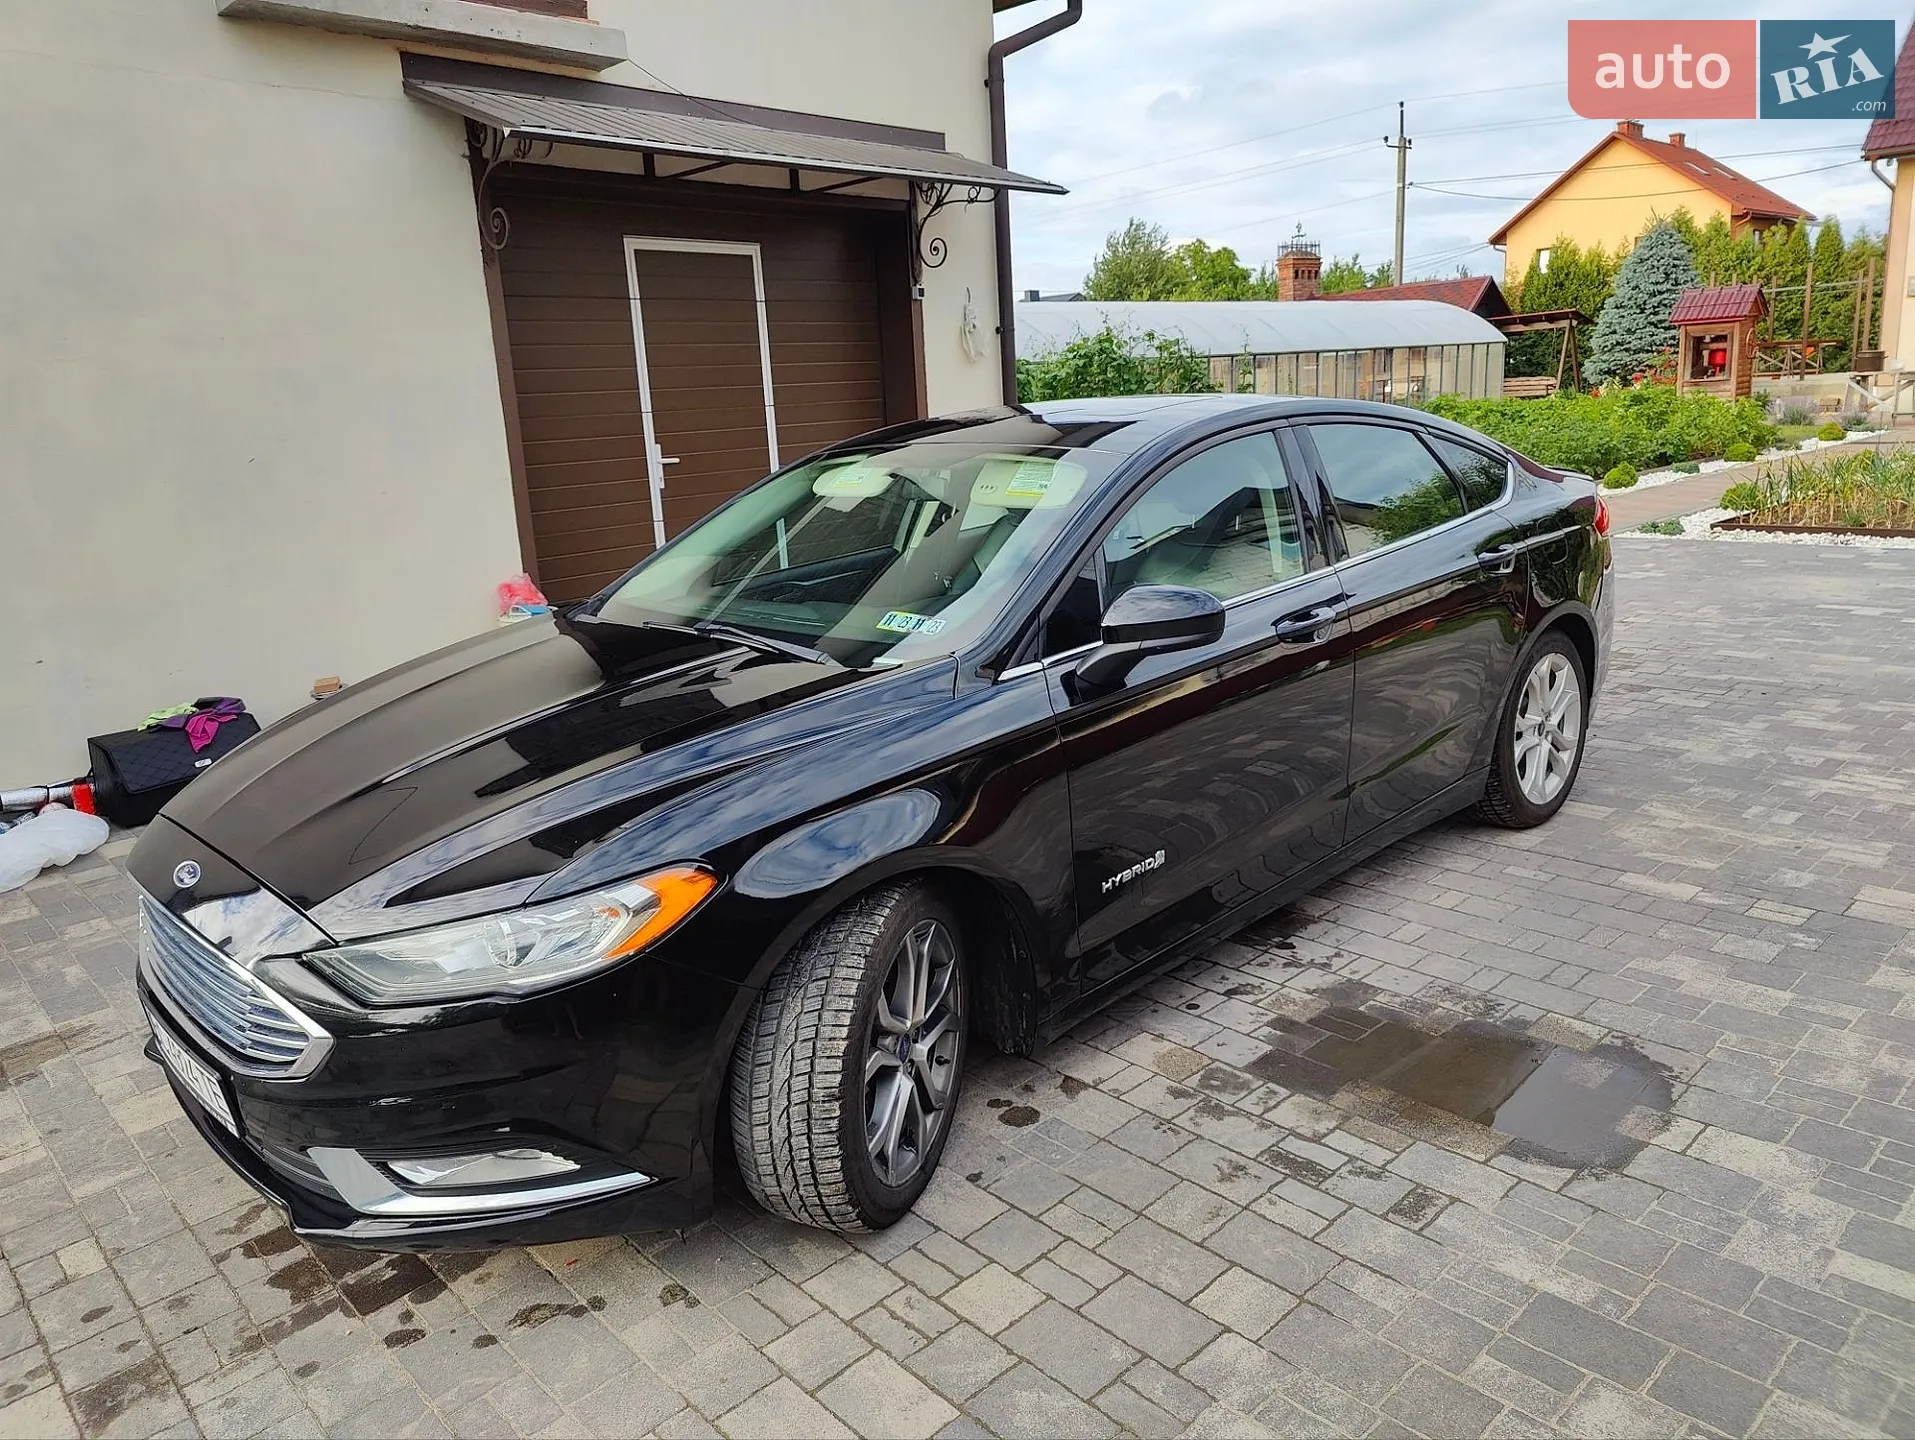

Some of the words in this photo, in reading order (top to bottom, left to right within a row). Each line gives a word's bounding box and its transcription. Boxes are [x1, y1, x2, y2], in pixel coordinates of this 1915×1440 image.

[884, 613, 898, 626] 11
[897, 615, 913, 629] 23
[911, 618, 927, 631] 11
[1101, 857, 1155, 894] HYBRID
